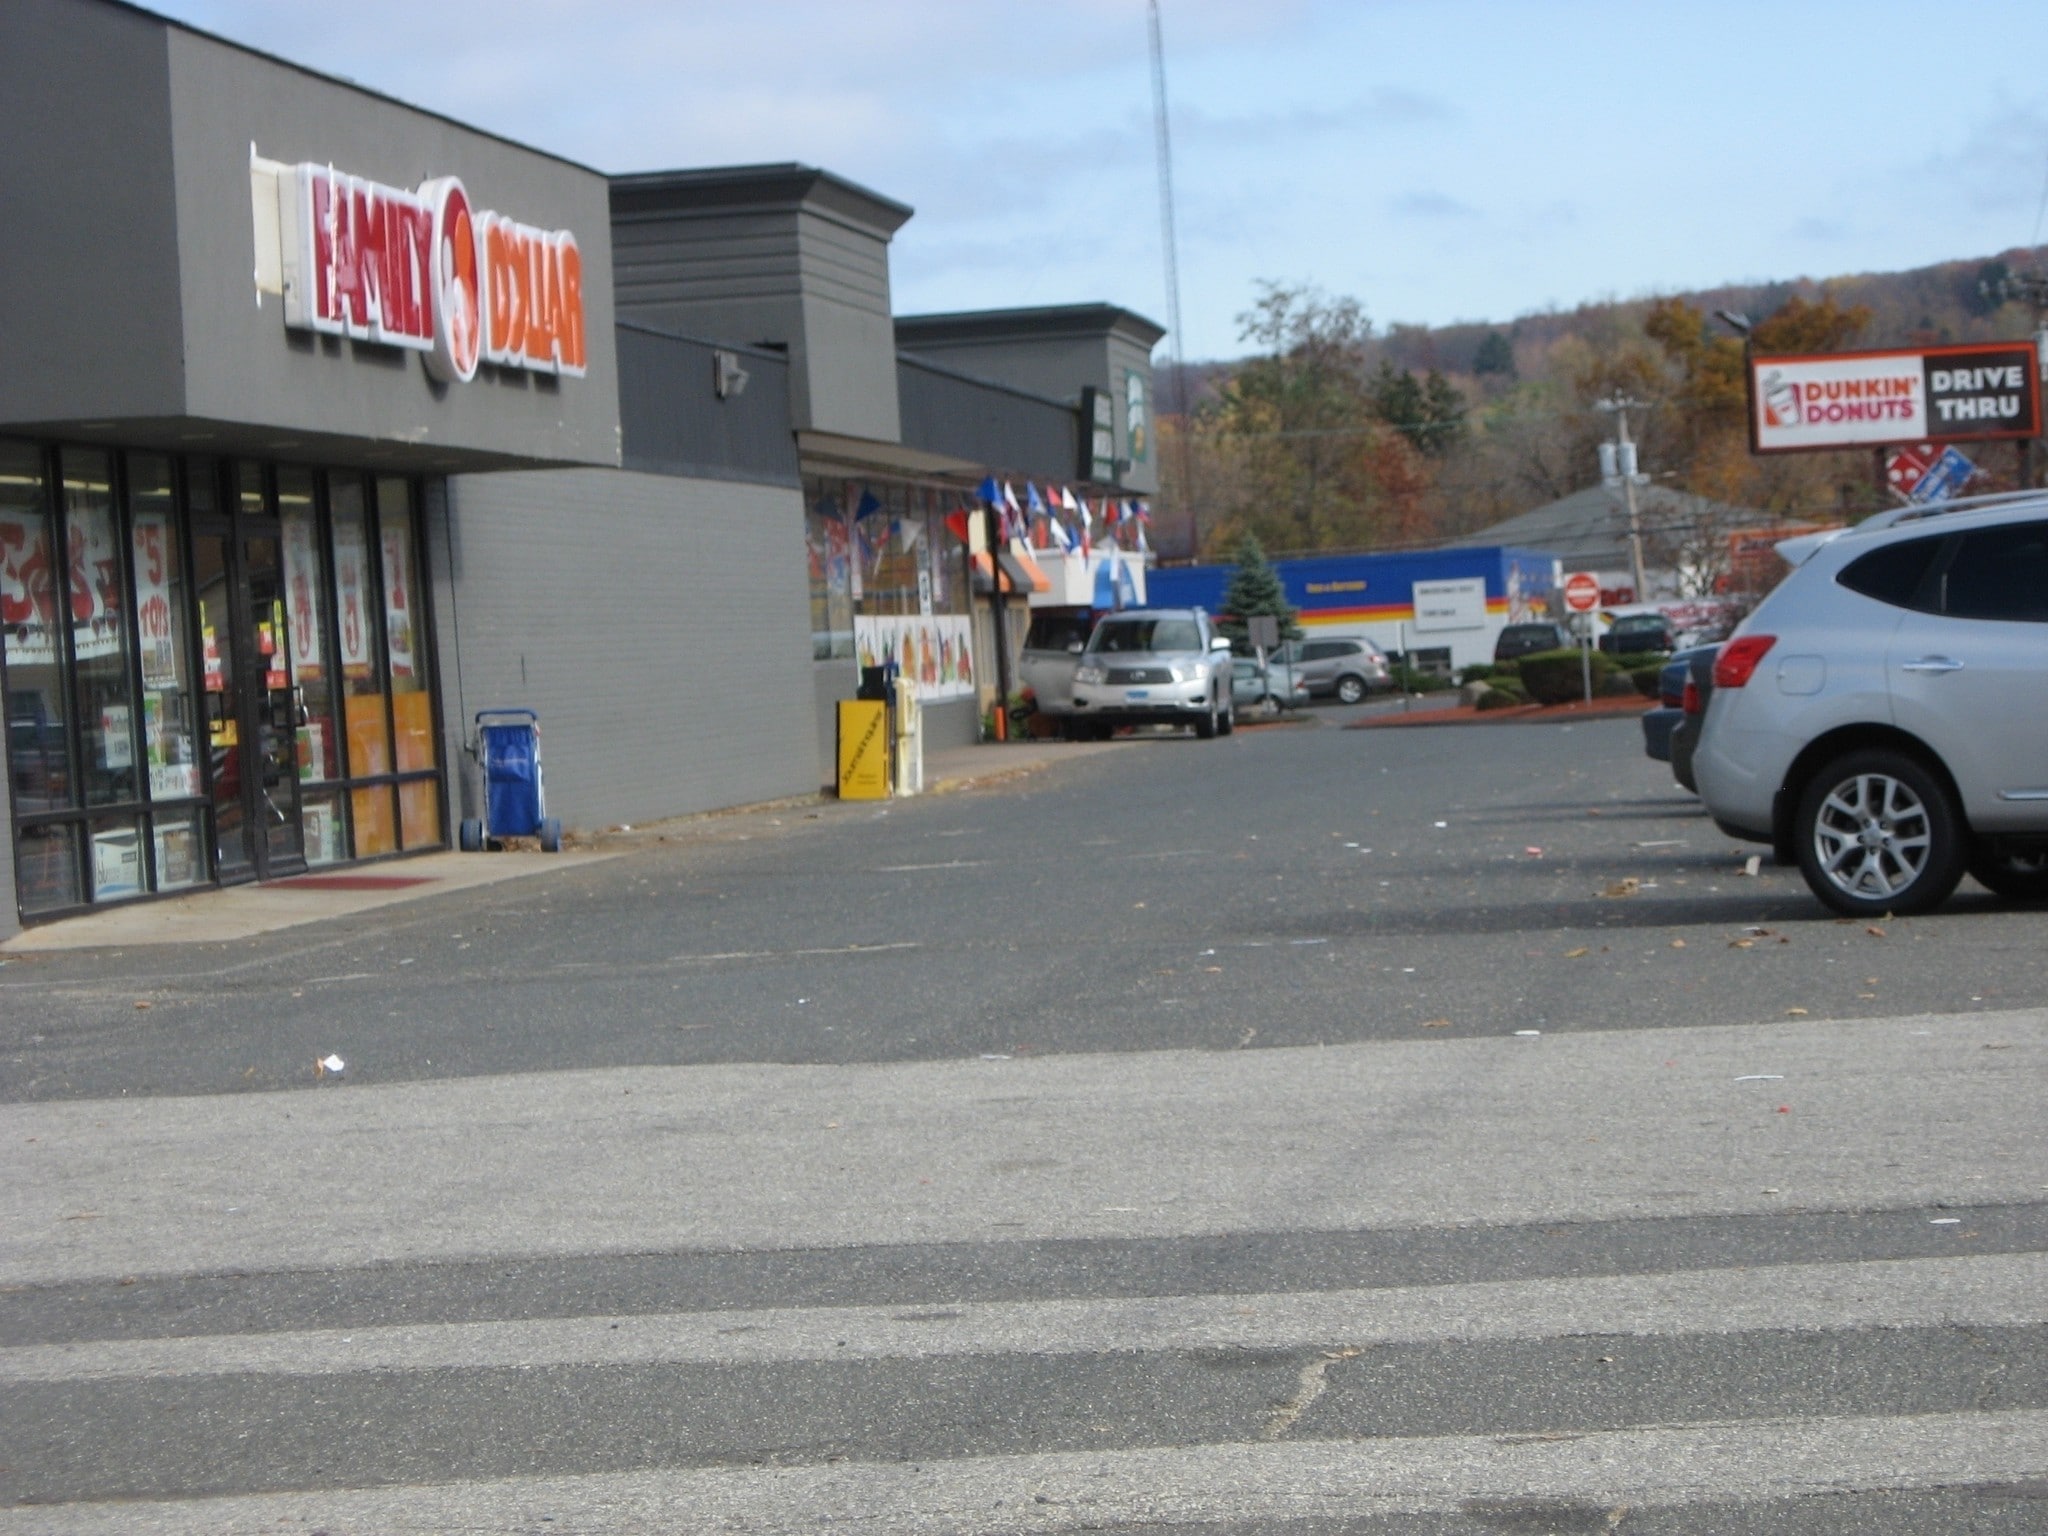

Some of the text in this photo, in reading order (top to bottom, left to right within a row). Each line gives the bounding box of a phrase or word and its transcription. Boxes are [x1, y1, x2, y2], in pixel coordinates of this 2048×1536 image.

[486, 222, 587, 371] DOLLAR
[1806, 377, 1918, 400] DUNKIN'
[1932, 366, 2023, 392] DRIVE
[1807, 400, 1913, 423] DONUTS
[1937, 396, 2019, 420] THRU
